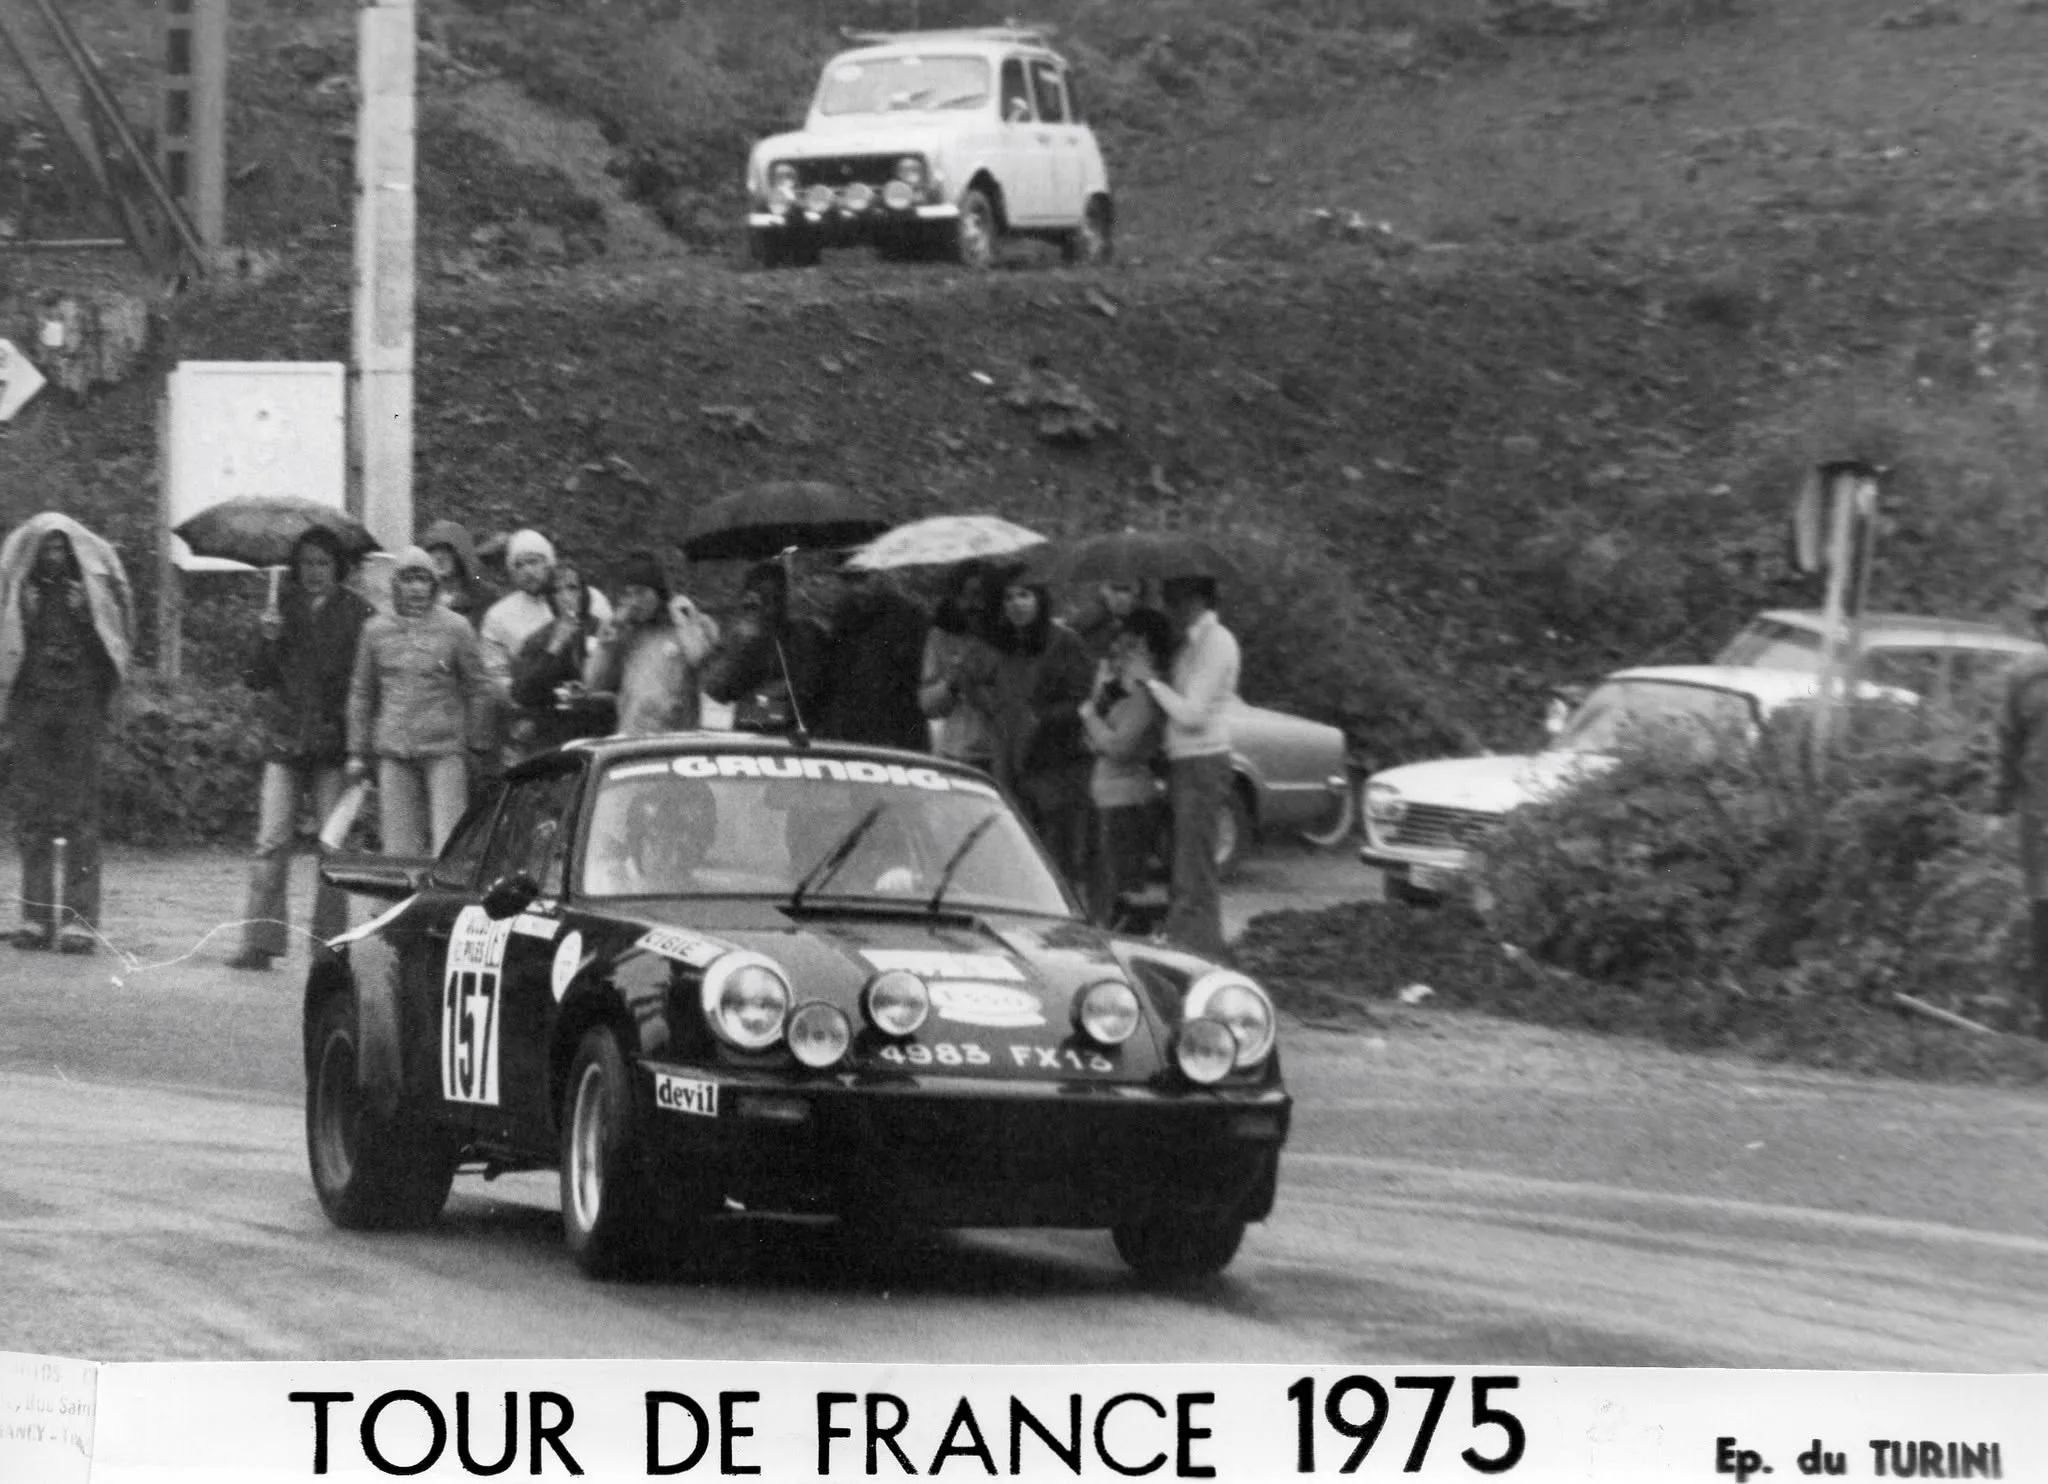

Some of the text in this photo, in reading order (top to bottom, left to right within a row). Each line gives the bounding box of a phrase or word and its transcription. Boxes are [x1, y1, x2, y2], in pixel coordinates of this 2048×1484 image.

[672, 755, 951, 791] GRUNDIG
[446, 970, 498, 1100] 157
[657, 1077, 715, 1114] devil
